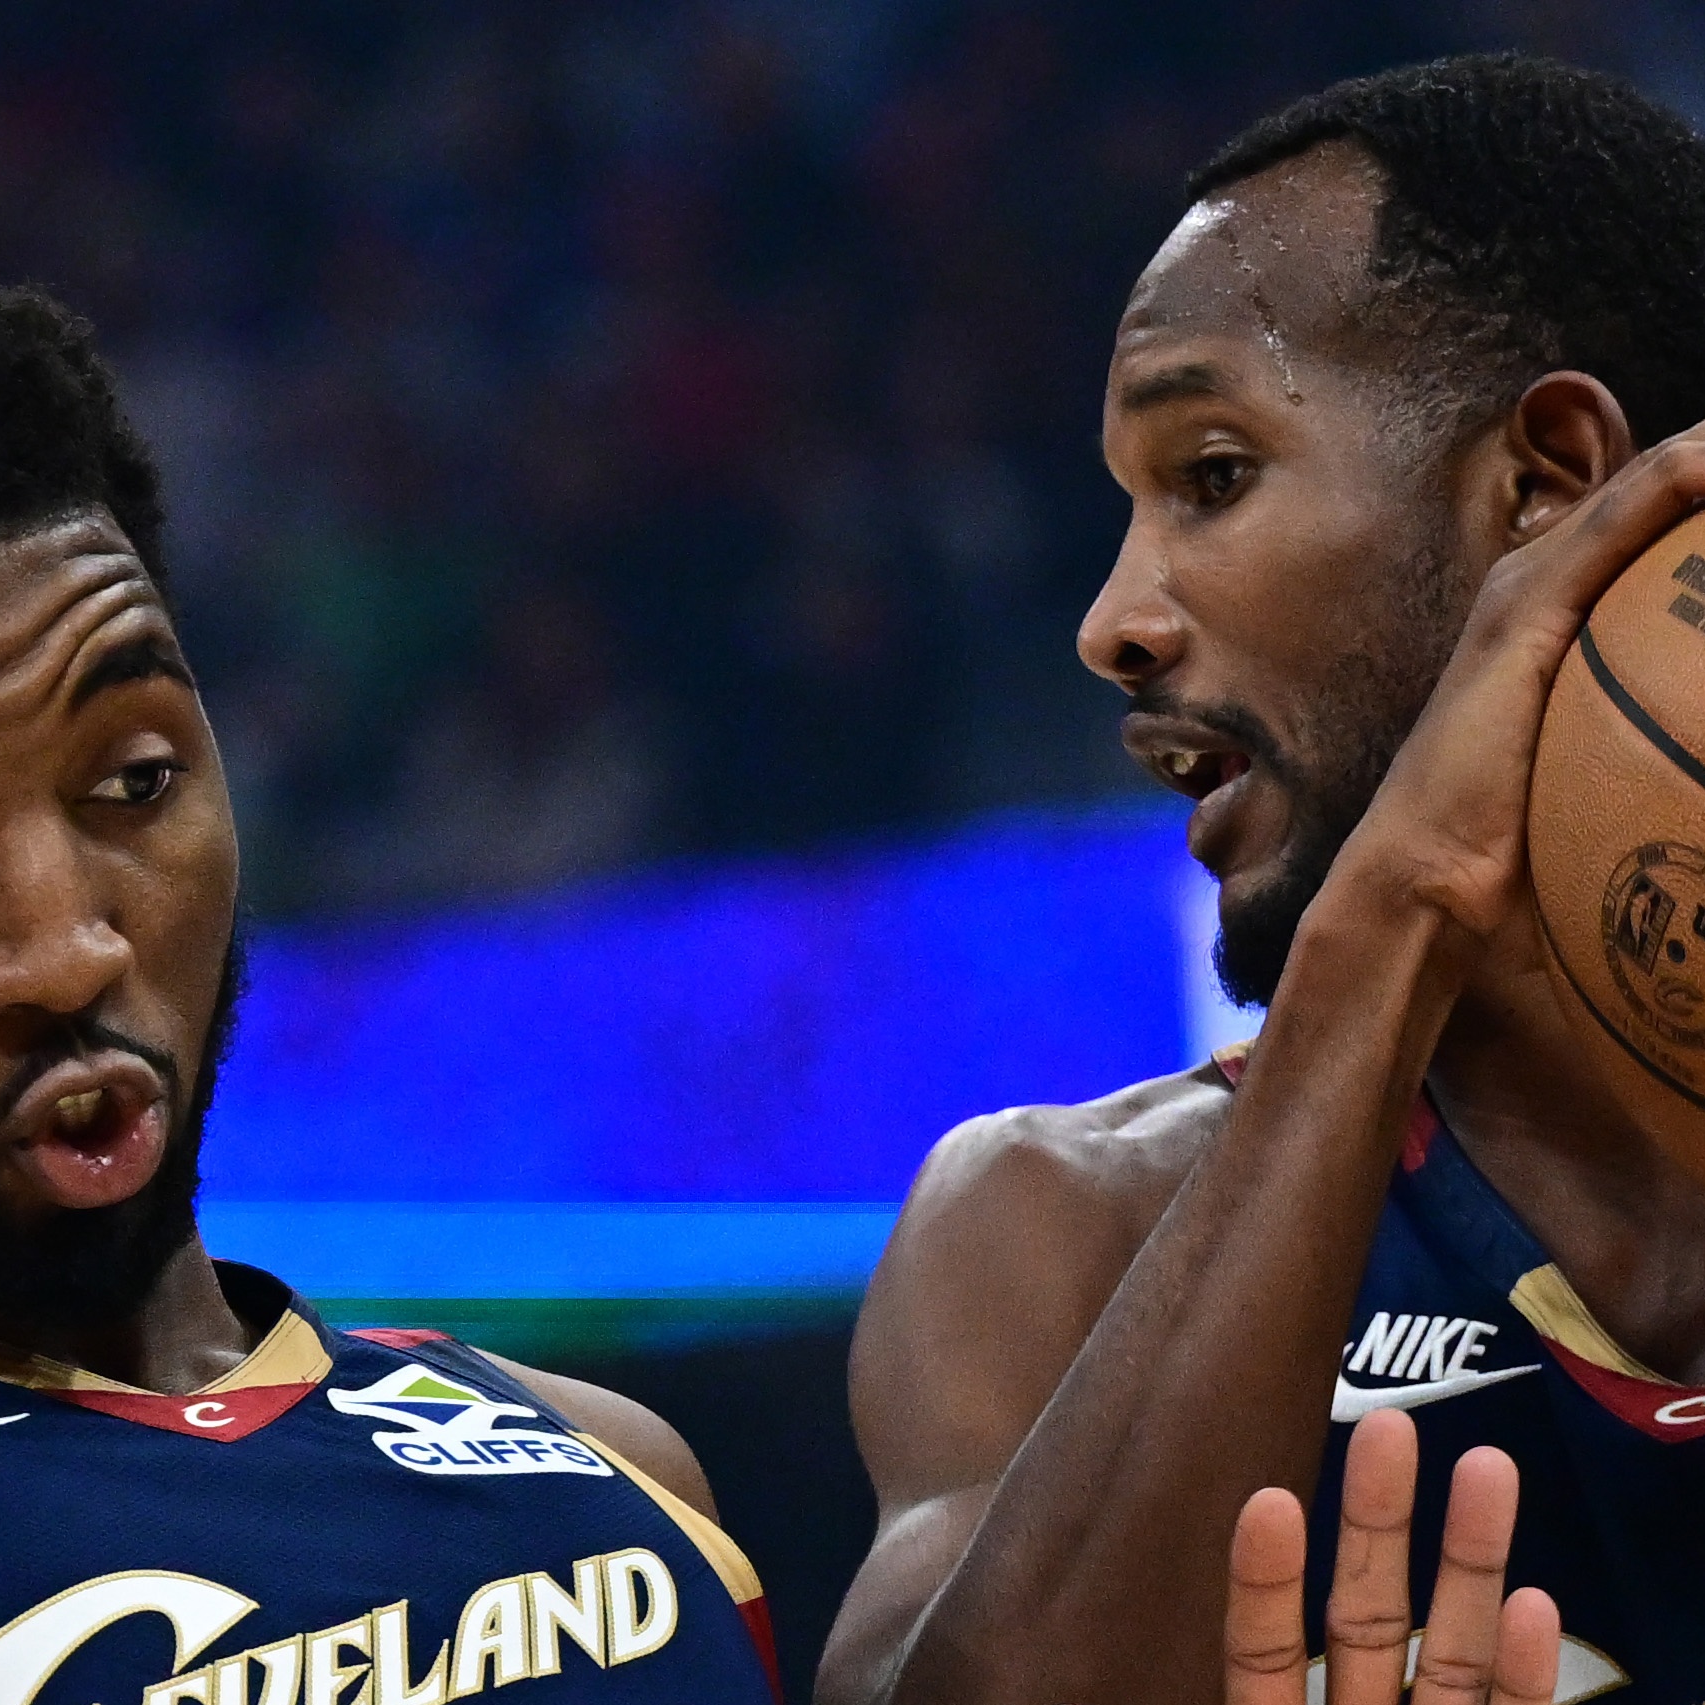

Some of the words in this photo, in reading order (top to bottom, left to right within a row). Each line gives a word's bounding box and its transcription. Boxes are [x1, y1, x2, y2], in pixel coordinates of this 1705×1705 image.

[1348, 1311, 1498, 1381] NIKE
[182, 1401, 236, 1428] C
[390, 1439, 600, 1468] CLIFFS
